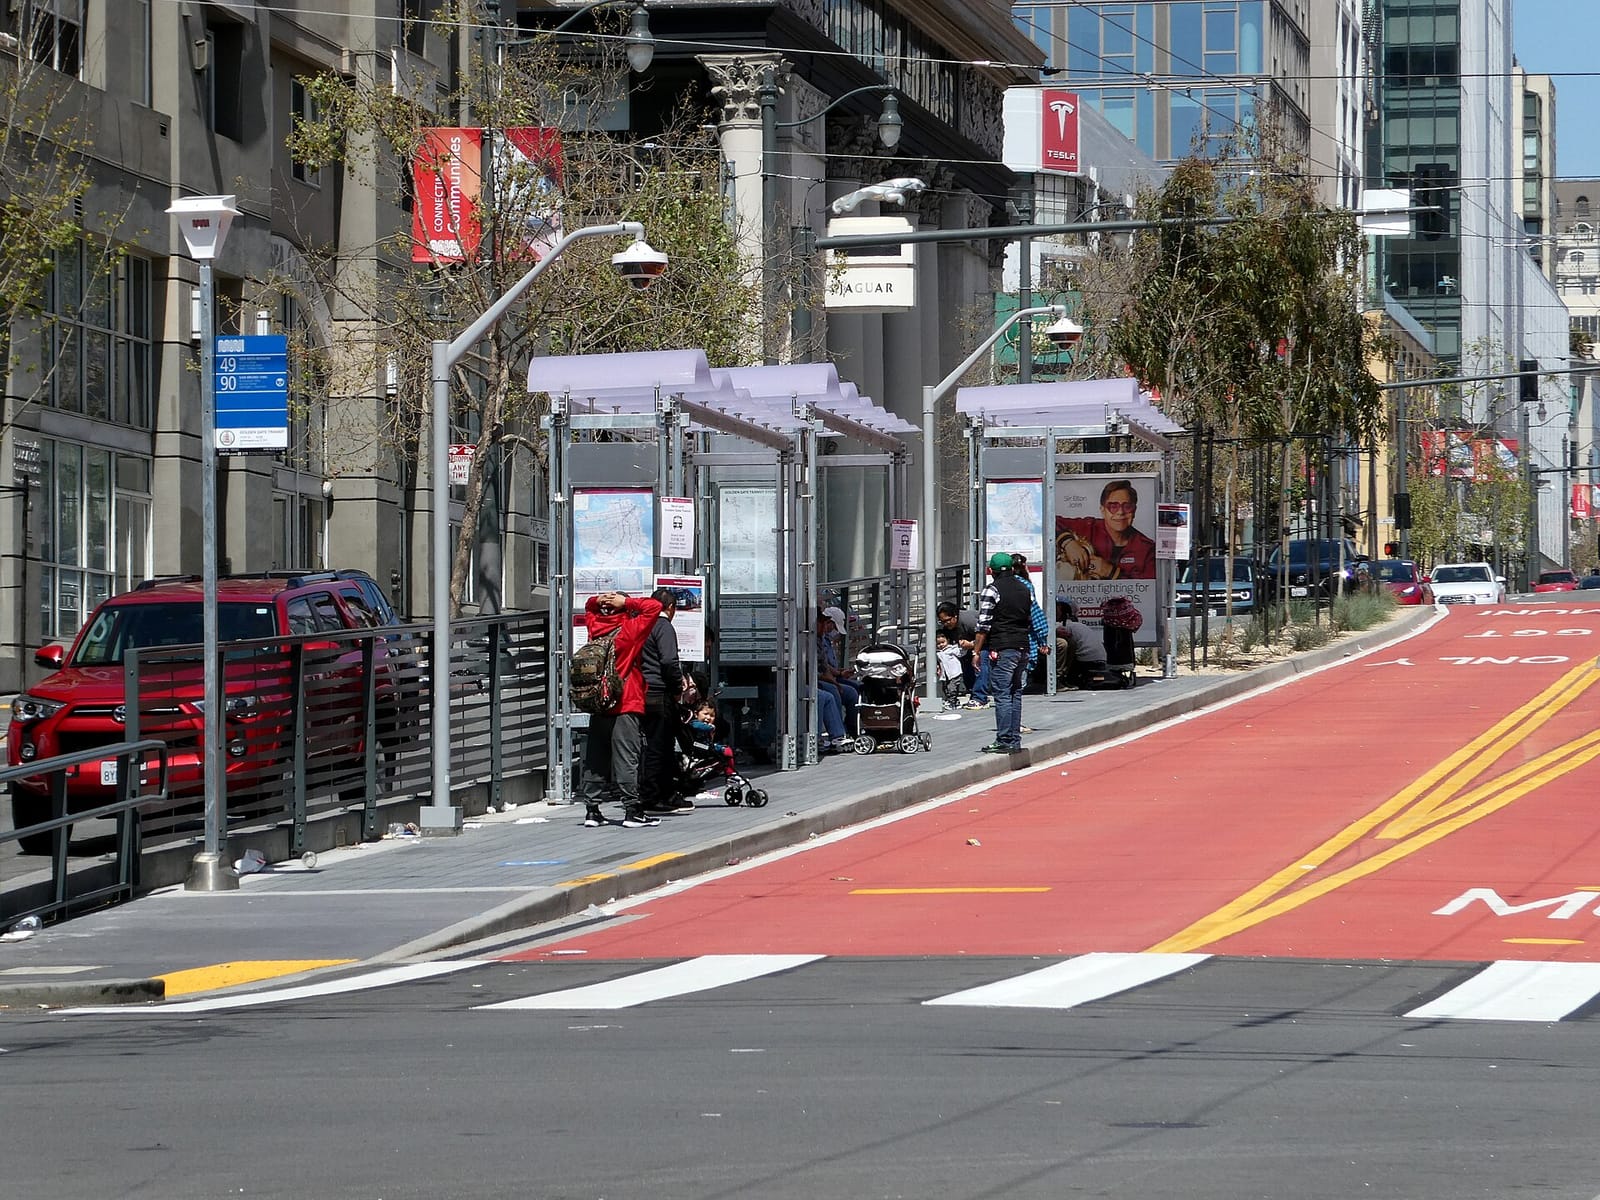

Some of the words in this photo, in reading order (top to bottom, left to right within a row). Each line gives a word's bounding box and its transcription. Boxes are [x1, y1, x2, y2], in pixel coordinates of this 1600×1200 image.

[1047, 150, 1076, 160] TESLA
[434, 168, 443, 233] CONNECTIN
[840, 283, 893, 295] JAGUAR
[220, 357, 236, 372] 49
[220, 376, 236, 391] 90
[1058, 584, 1065, 593] A
[1066, 583, 1096, 595] knight
[1097, 583, 1134, 595] fighting
[1135, 582, 1149, 592] for
[1464, 629, 1593, 638] GGT
